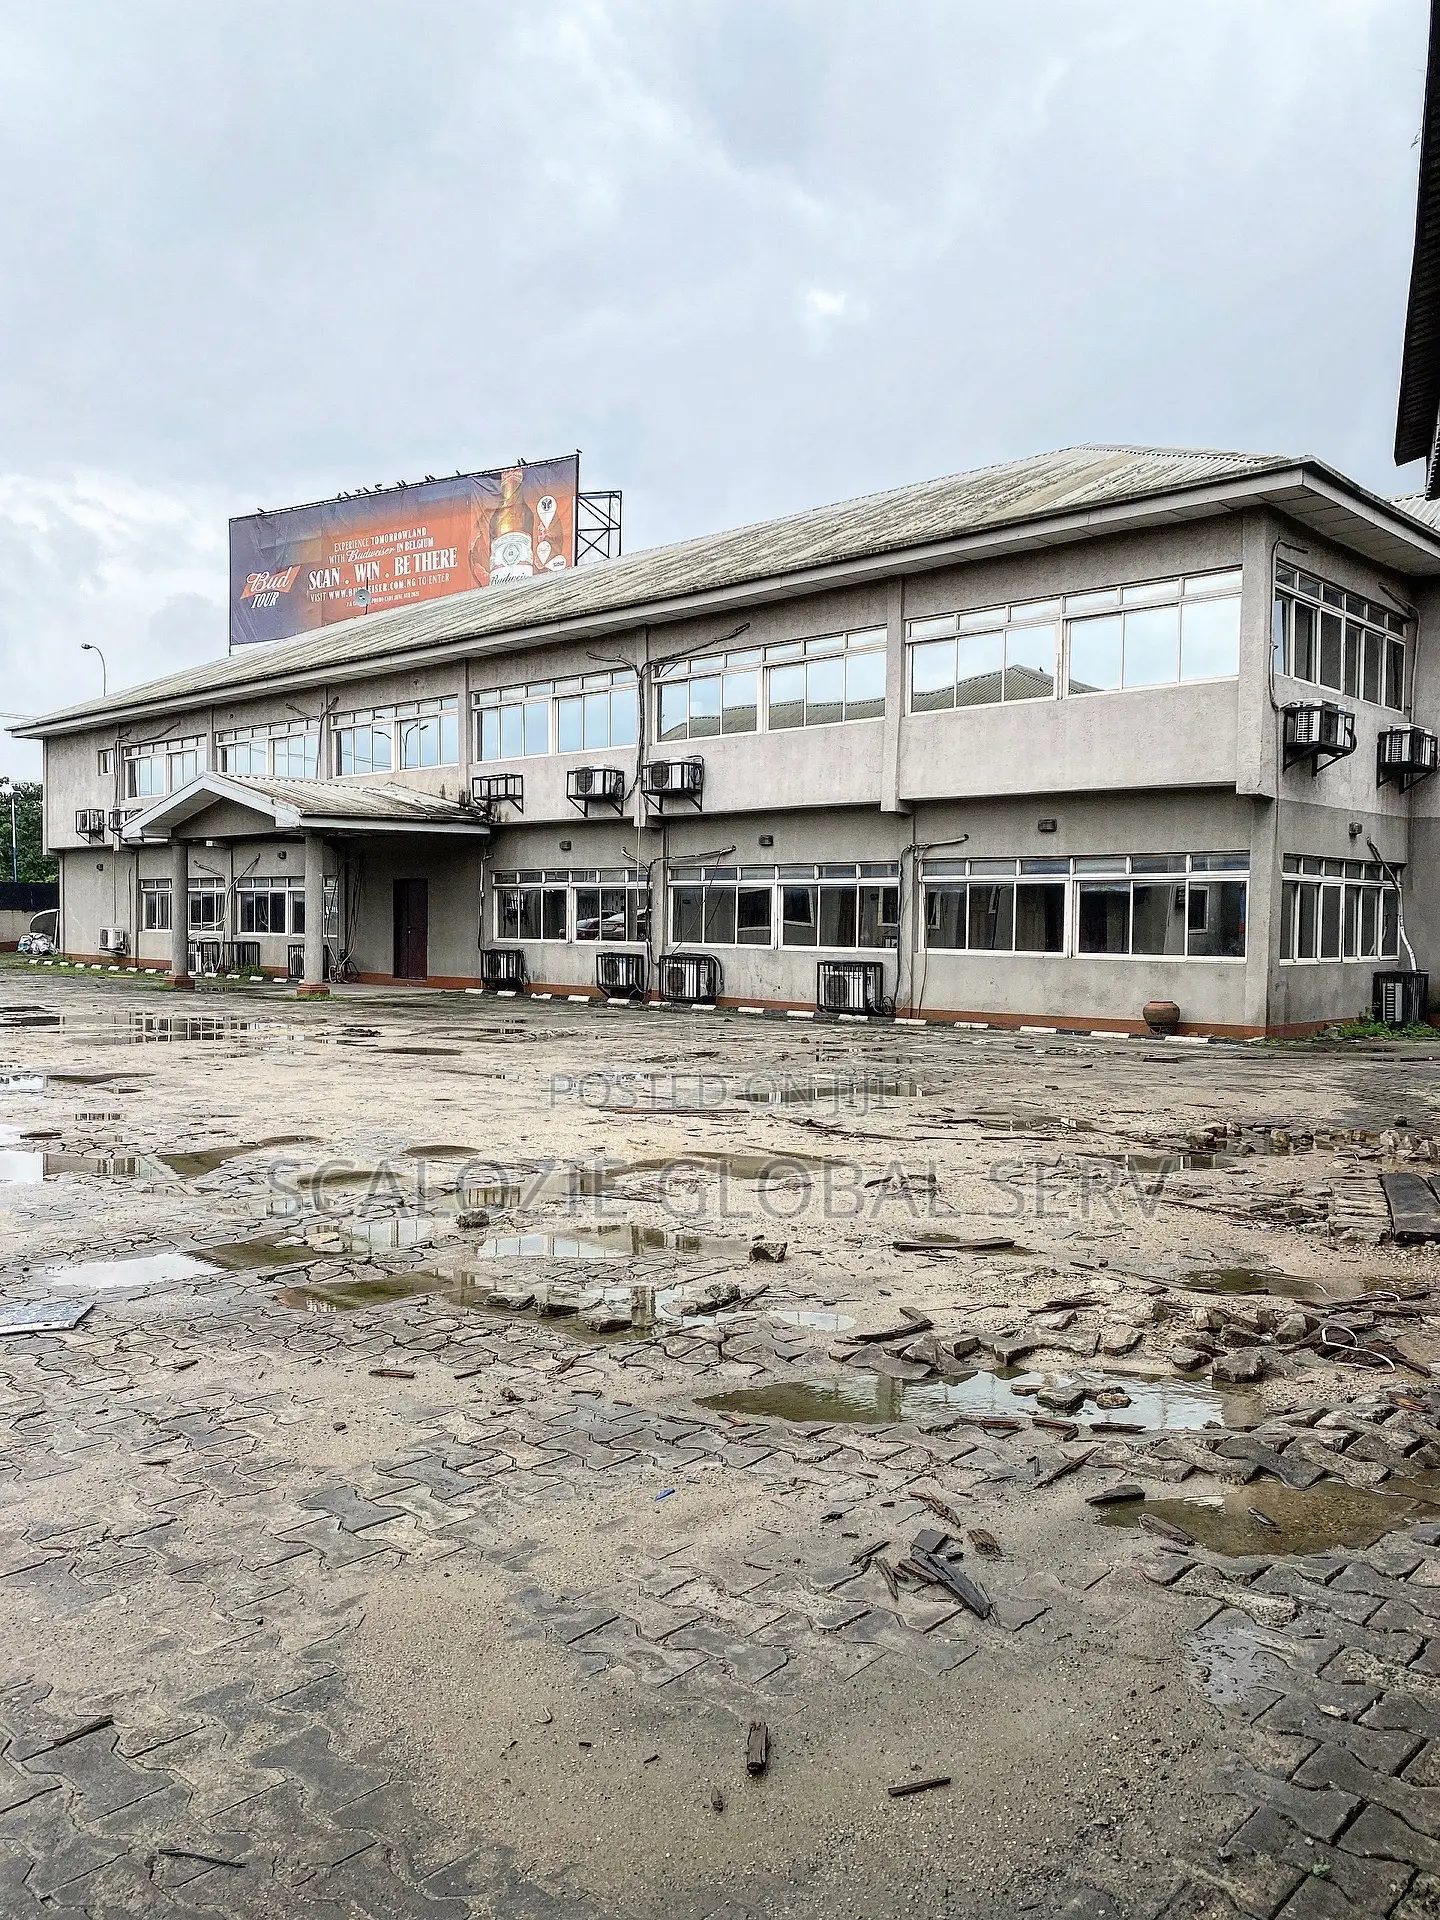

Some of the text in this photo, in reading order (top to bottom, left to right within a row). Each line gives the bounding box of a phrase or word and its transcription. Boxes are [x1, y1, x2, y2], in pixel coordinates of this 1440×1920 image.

[328, 537, 434, 565] WITH Budweiser IN BELGIUM
[334, 527, 427, 553] EXPERIENCE TOMORROWLAND
[245, 568, 290, 592] Bud
[308, 567, 340, 591] SCAN
[354, 560, 380, 583] WIN
[394, 555, 411, 577] BE
[412, 547, 458, 572] THERE
[251, 591, 280, 609] TOUR
[310, 591, 327, 603] VISIT
[417, 576, 428, 586] TO
[428, 572, 450, 584] ENTER
